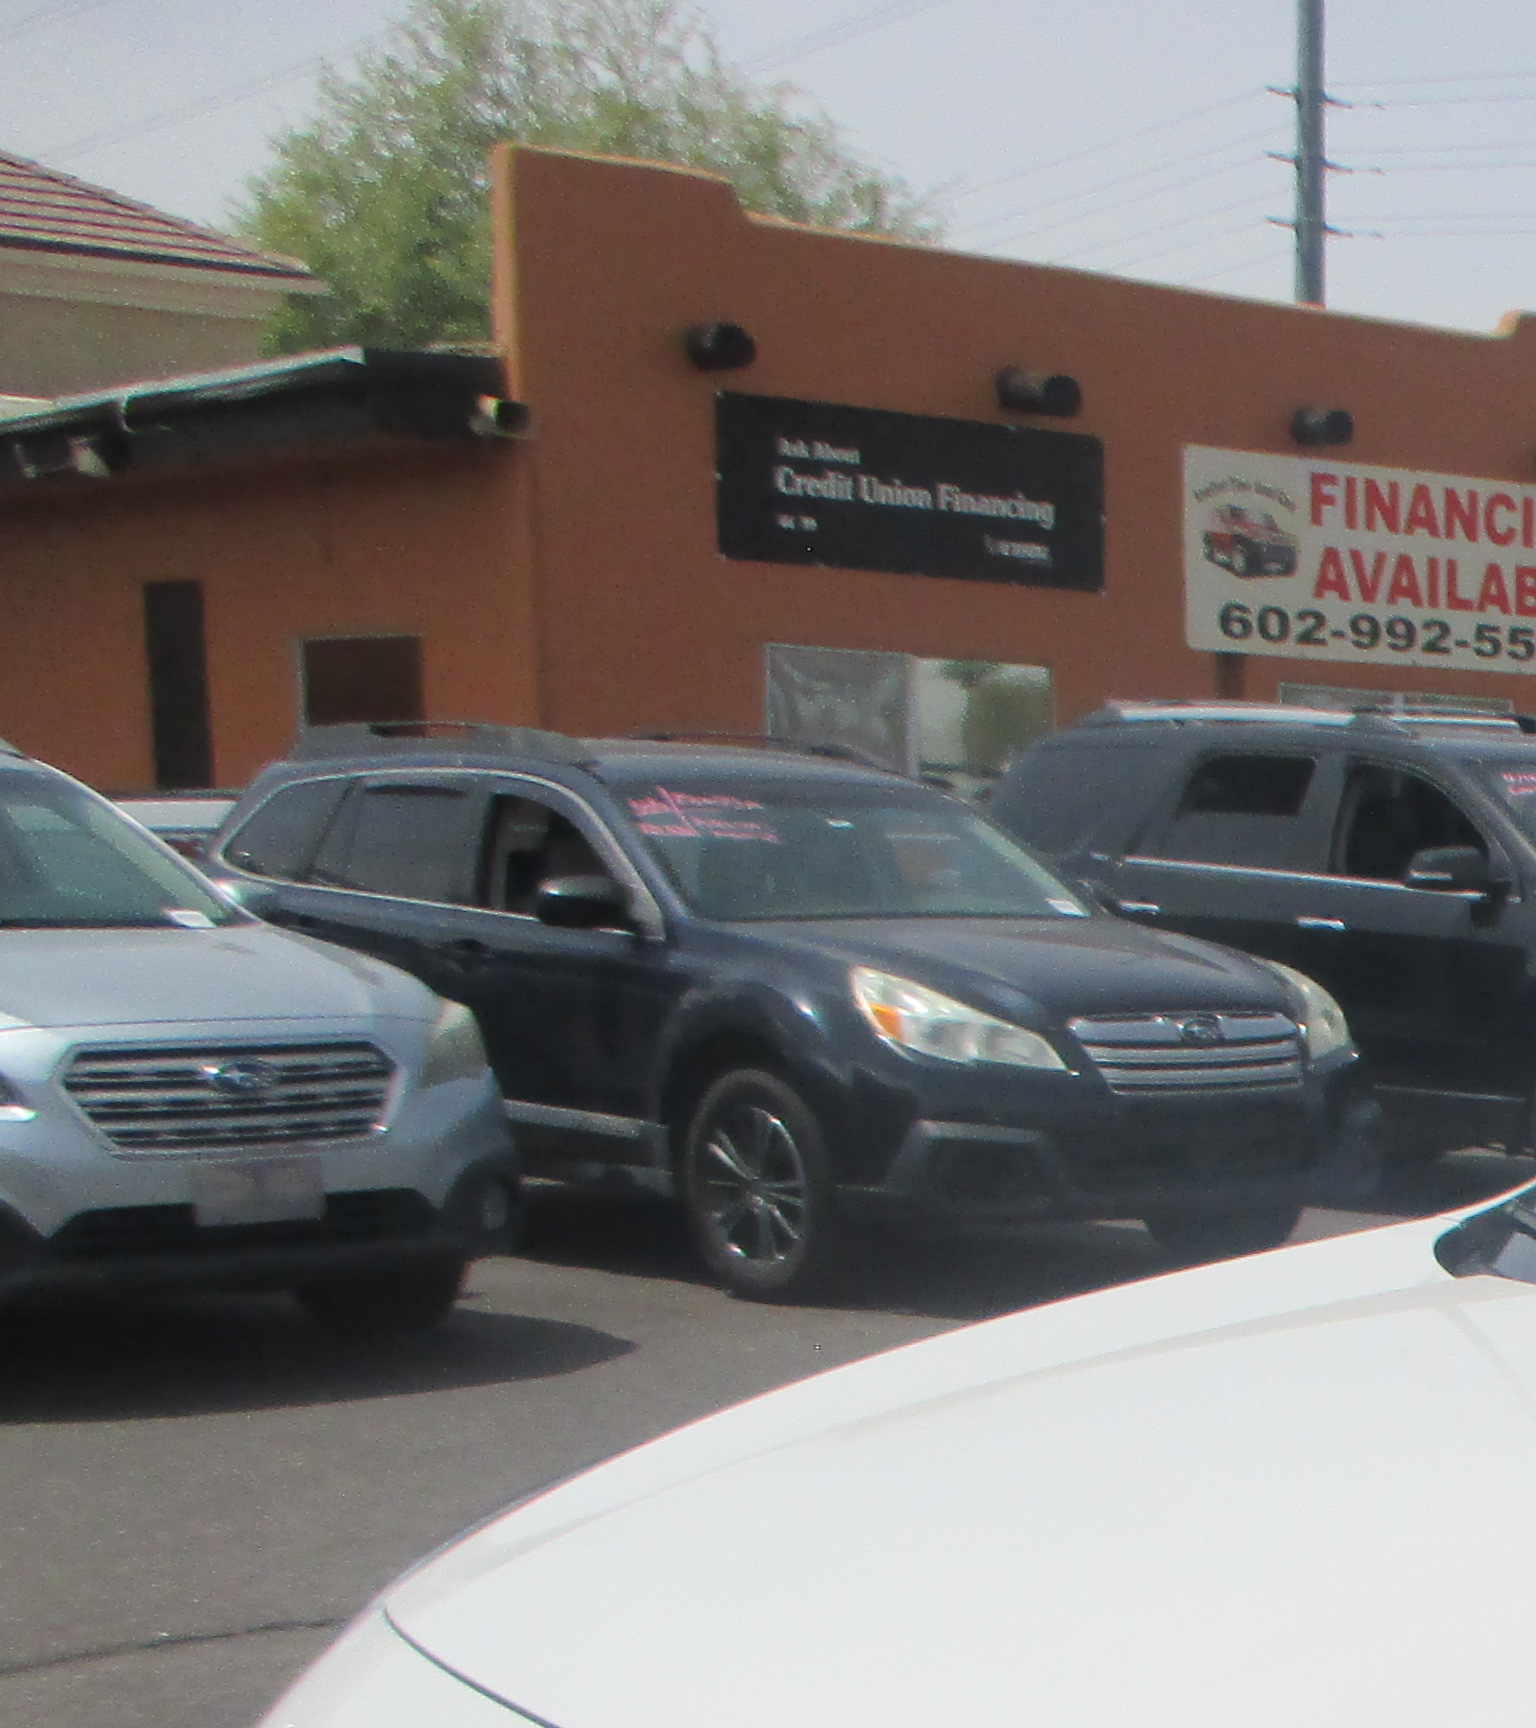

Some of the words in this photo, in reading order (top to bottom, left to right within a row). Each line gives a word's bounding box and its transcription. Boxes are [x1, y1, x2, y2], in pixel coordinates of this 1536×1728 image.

[775, 465, 854, 501] Credit
[857, 473, 933, 509] Union
[936, 482, 1056, 531] Financing
